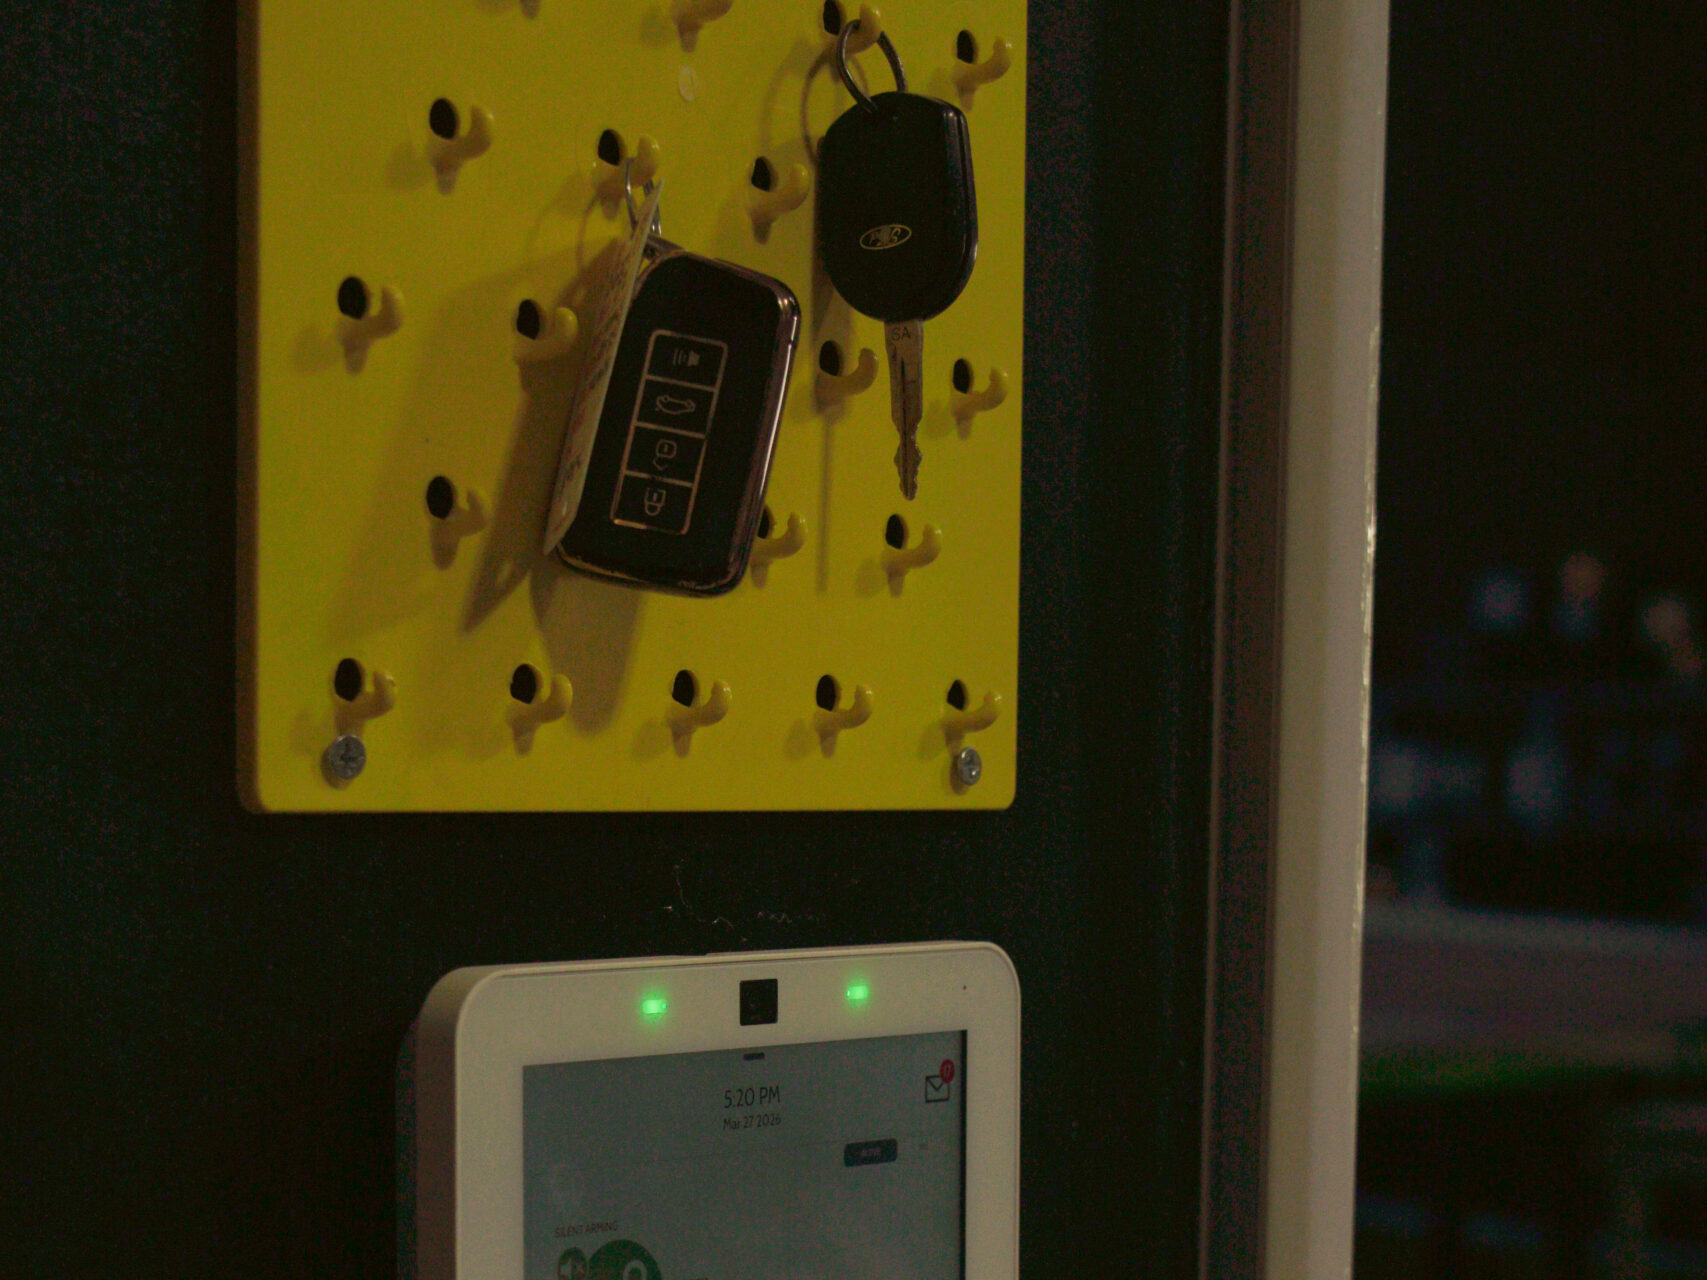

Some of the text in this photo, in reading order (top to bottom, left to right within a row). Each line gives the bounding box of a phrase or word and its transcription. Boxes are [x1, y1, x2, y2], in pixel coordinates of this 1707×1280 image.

[723, 1085, 781, 1109] 5:20 PM
[723, 1113, 782, 1131] Mar 27 2026
[585, 1220, 619, 1234] ARMING
